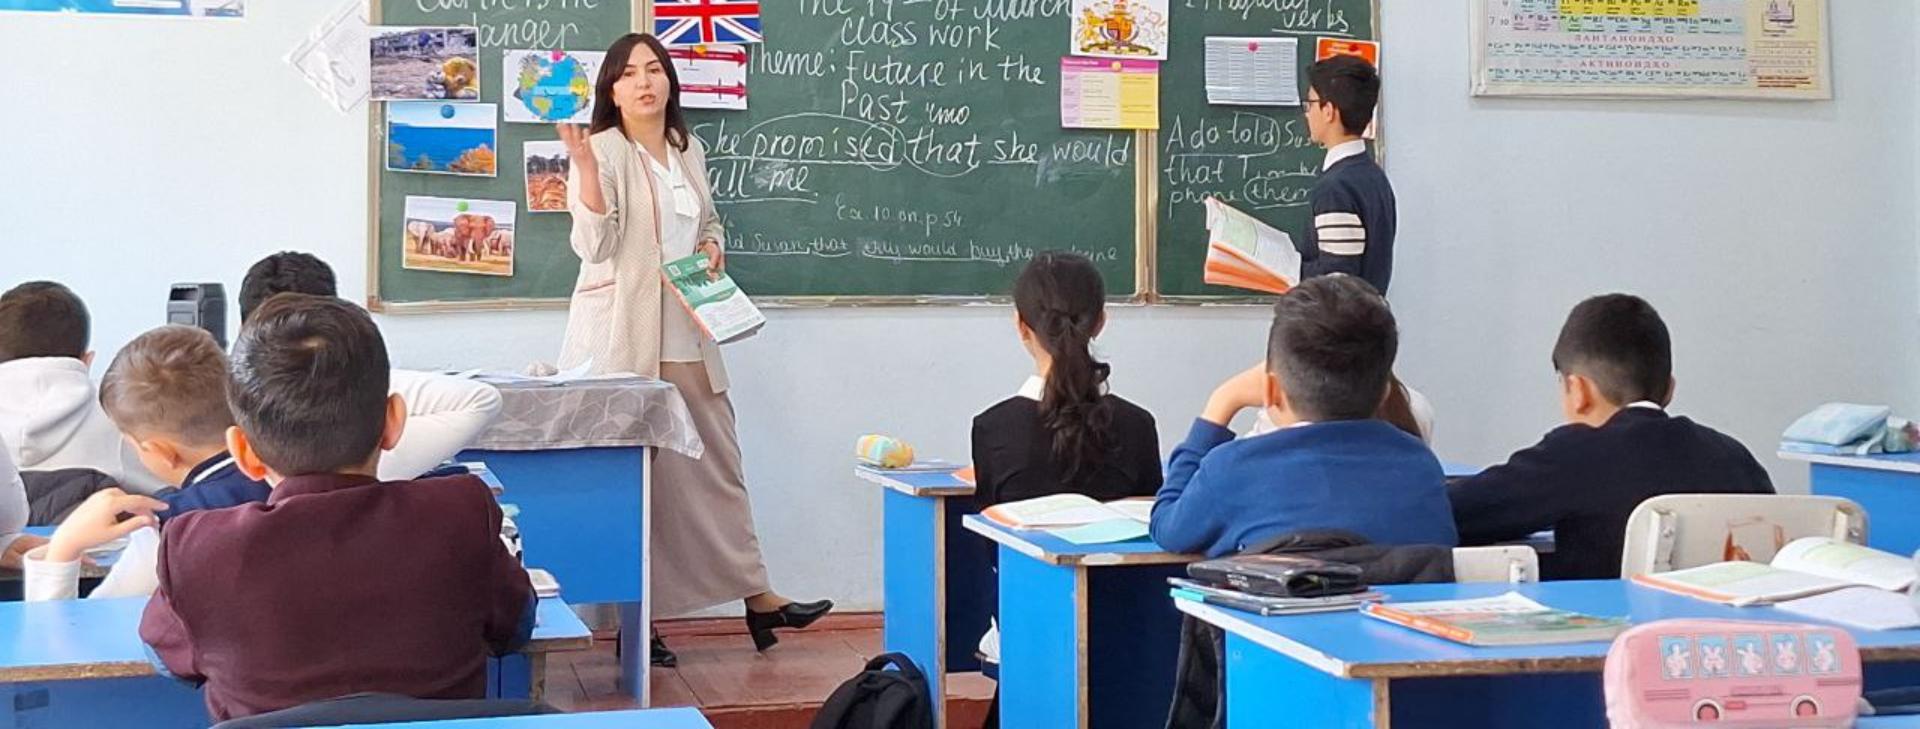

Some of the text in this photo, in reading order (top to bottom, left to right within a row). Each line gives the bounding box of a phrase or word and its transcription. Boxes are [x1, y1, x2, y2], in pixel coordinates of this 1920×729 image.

[929, 18, 1001, 51] work
[845, 50, 947, 87] Future
[958, 57, 986, 85] in
[997, 55, 1046, 85] the
[841, 79, 909, 123] Past
[907, 127, 982, 167] that
[992, 131, 1038, 162] she
[1053, 134, 1130, 168] would
[708, 161, 751, 198] all
[1164, 156, 1224, 186] that
